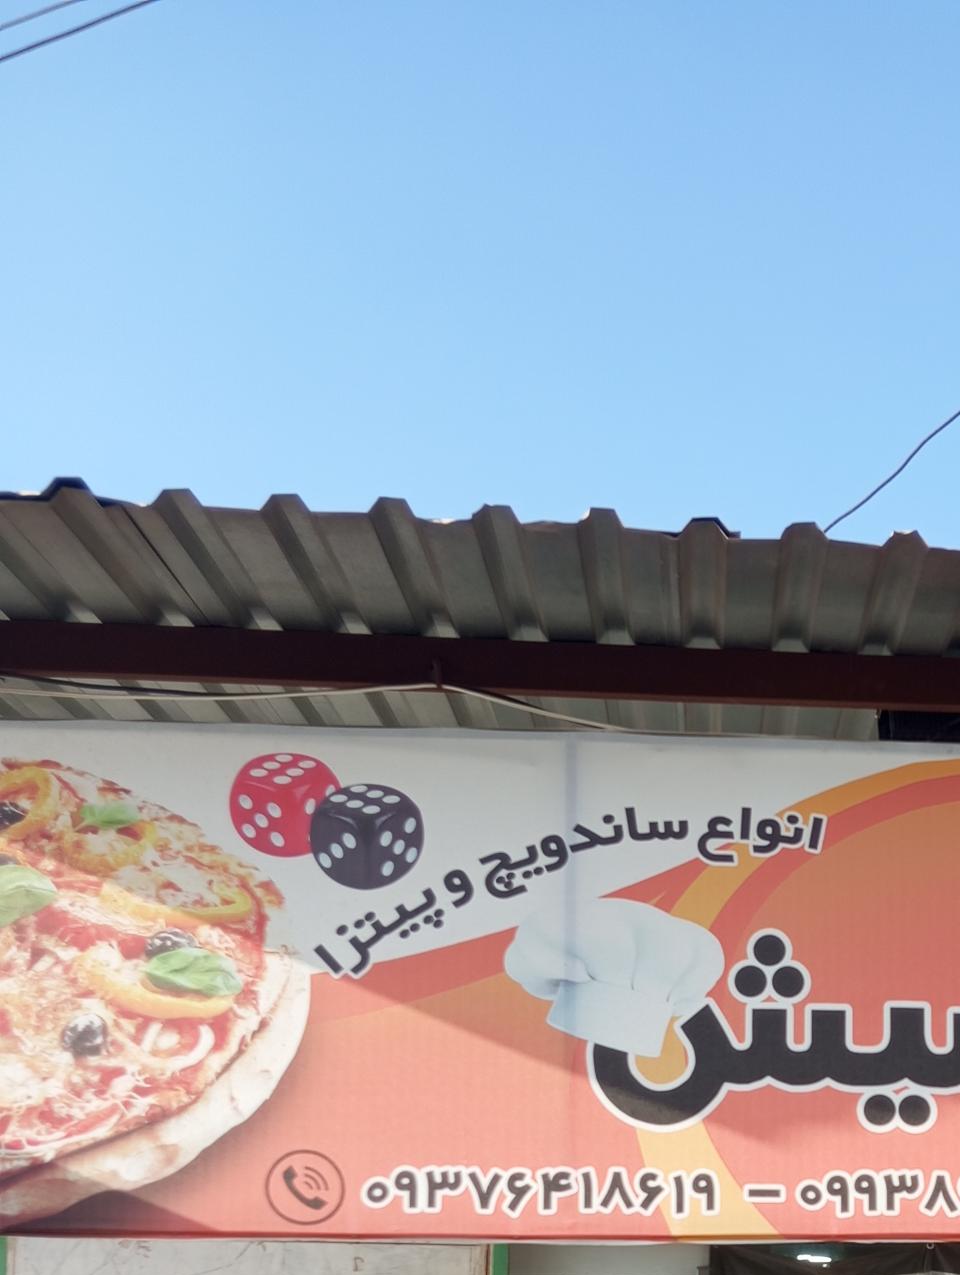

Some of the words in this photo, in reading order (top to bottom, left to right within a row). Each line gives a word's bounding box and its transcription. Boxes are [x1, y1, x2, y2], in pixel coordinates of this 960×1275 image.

[479, 807, 689, 899] ساندویچ
[699, 807, 824, 864] انواع
[444, 869, 474, 908] و
[313, 887, 444, 976] پیتزا
[364, 1167, 717, 1216] ۰۹۳۷۶۴۱۸۶۱۹
